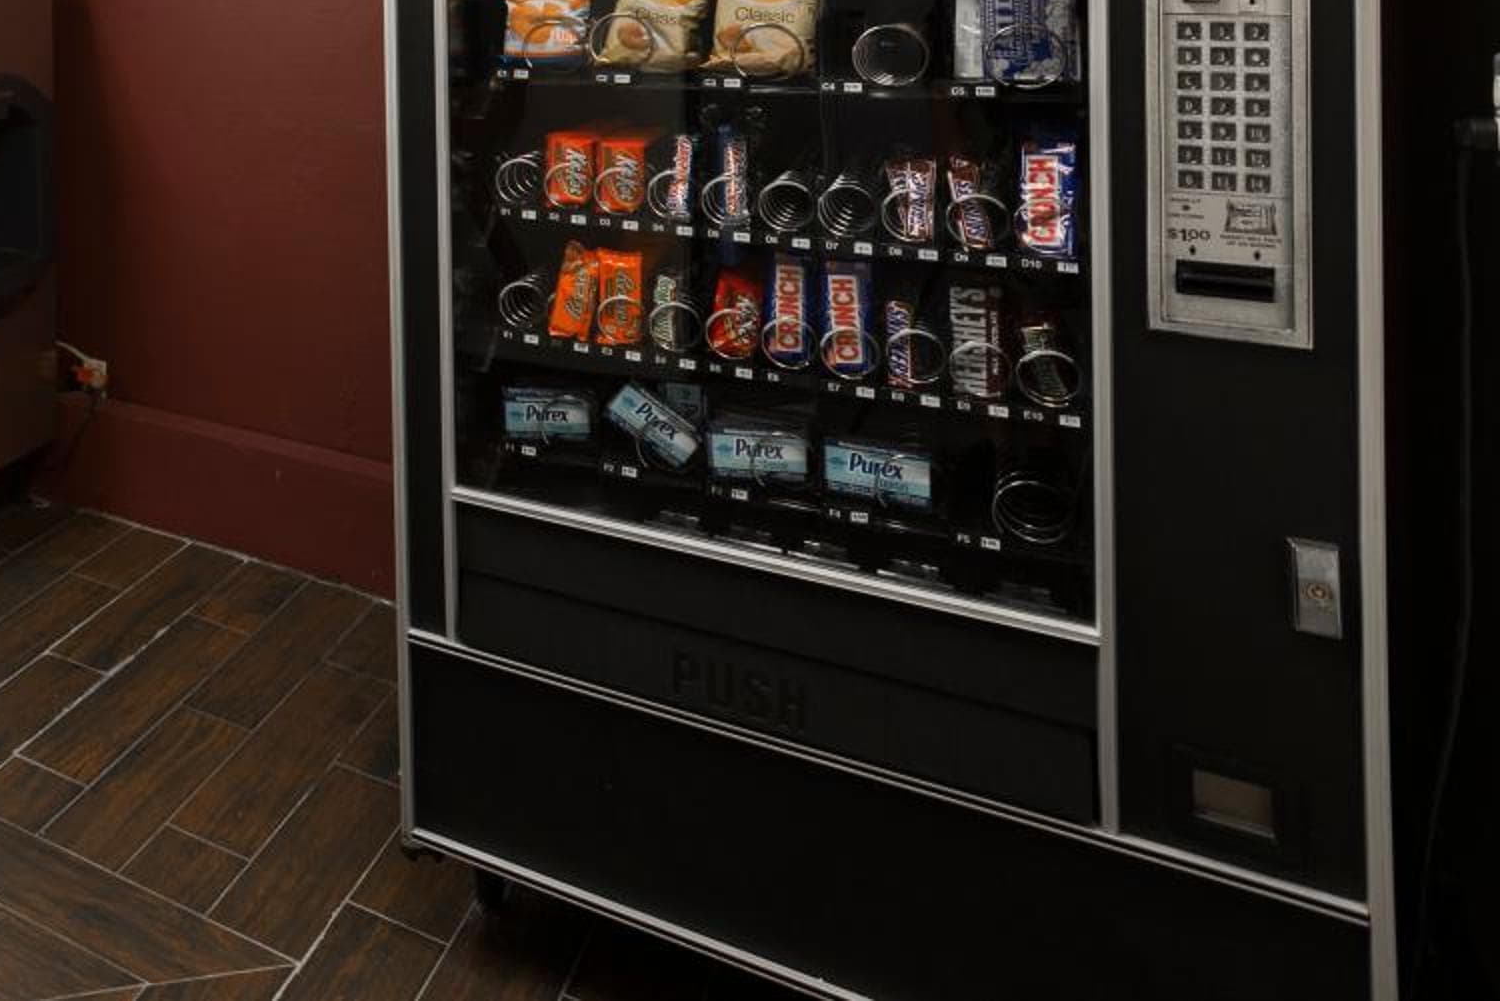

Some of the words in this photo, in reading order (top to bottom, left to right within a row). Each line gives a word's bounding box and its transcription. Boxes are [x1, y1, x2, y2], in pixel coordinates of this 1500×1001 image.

[526, 405, 568, 423] Purex
[636, 402, 677, 440] Purex
[735, 438, 784, 460] Purex
[849, 452, 904, 479] Purex
[673, 647, 807, 728] PUSH
